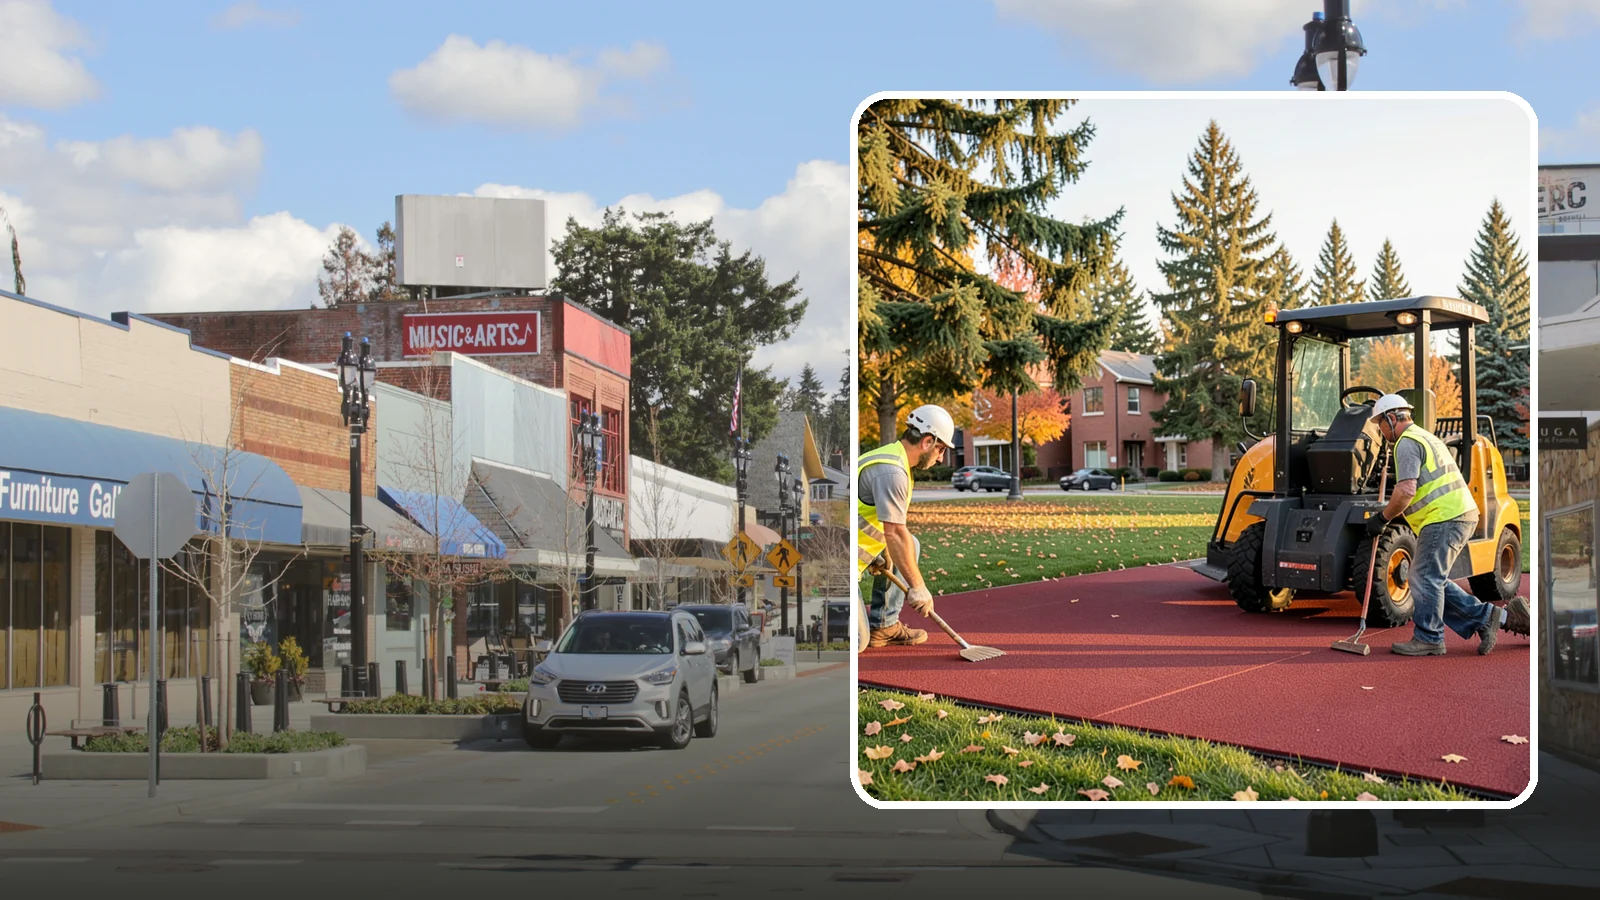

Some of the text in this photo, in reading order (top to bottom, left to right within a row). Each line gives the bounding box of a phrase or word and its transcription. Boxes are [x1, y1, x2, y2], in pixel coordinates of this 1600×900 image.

[1540, 427, 1578, 437] UGA
[0, 471, 122, 519] Furniture Gal
